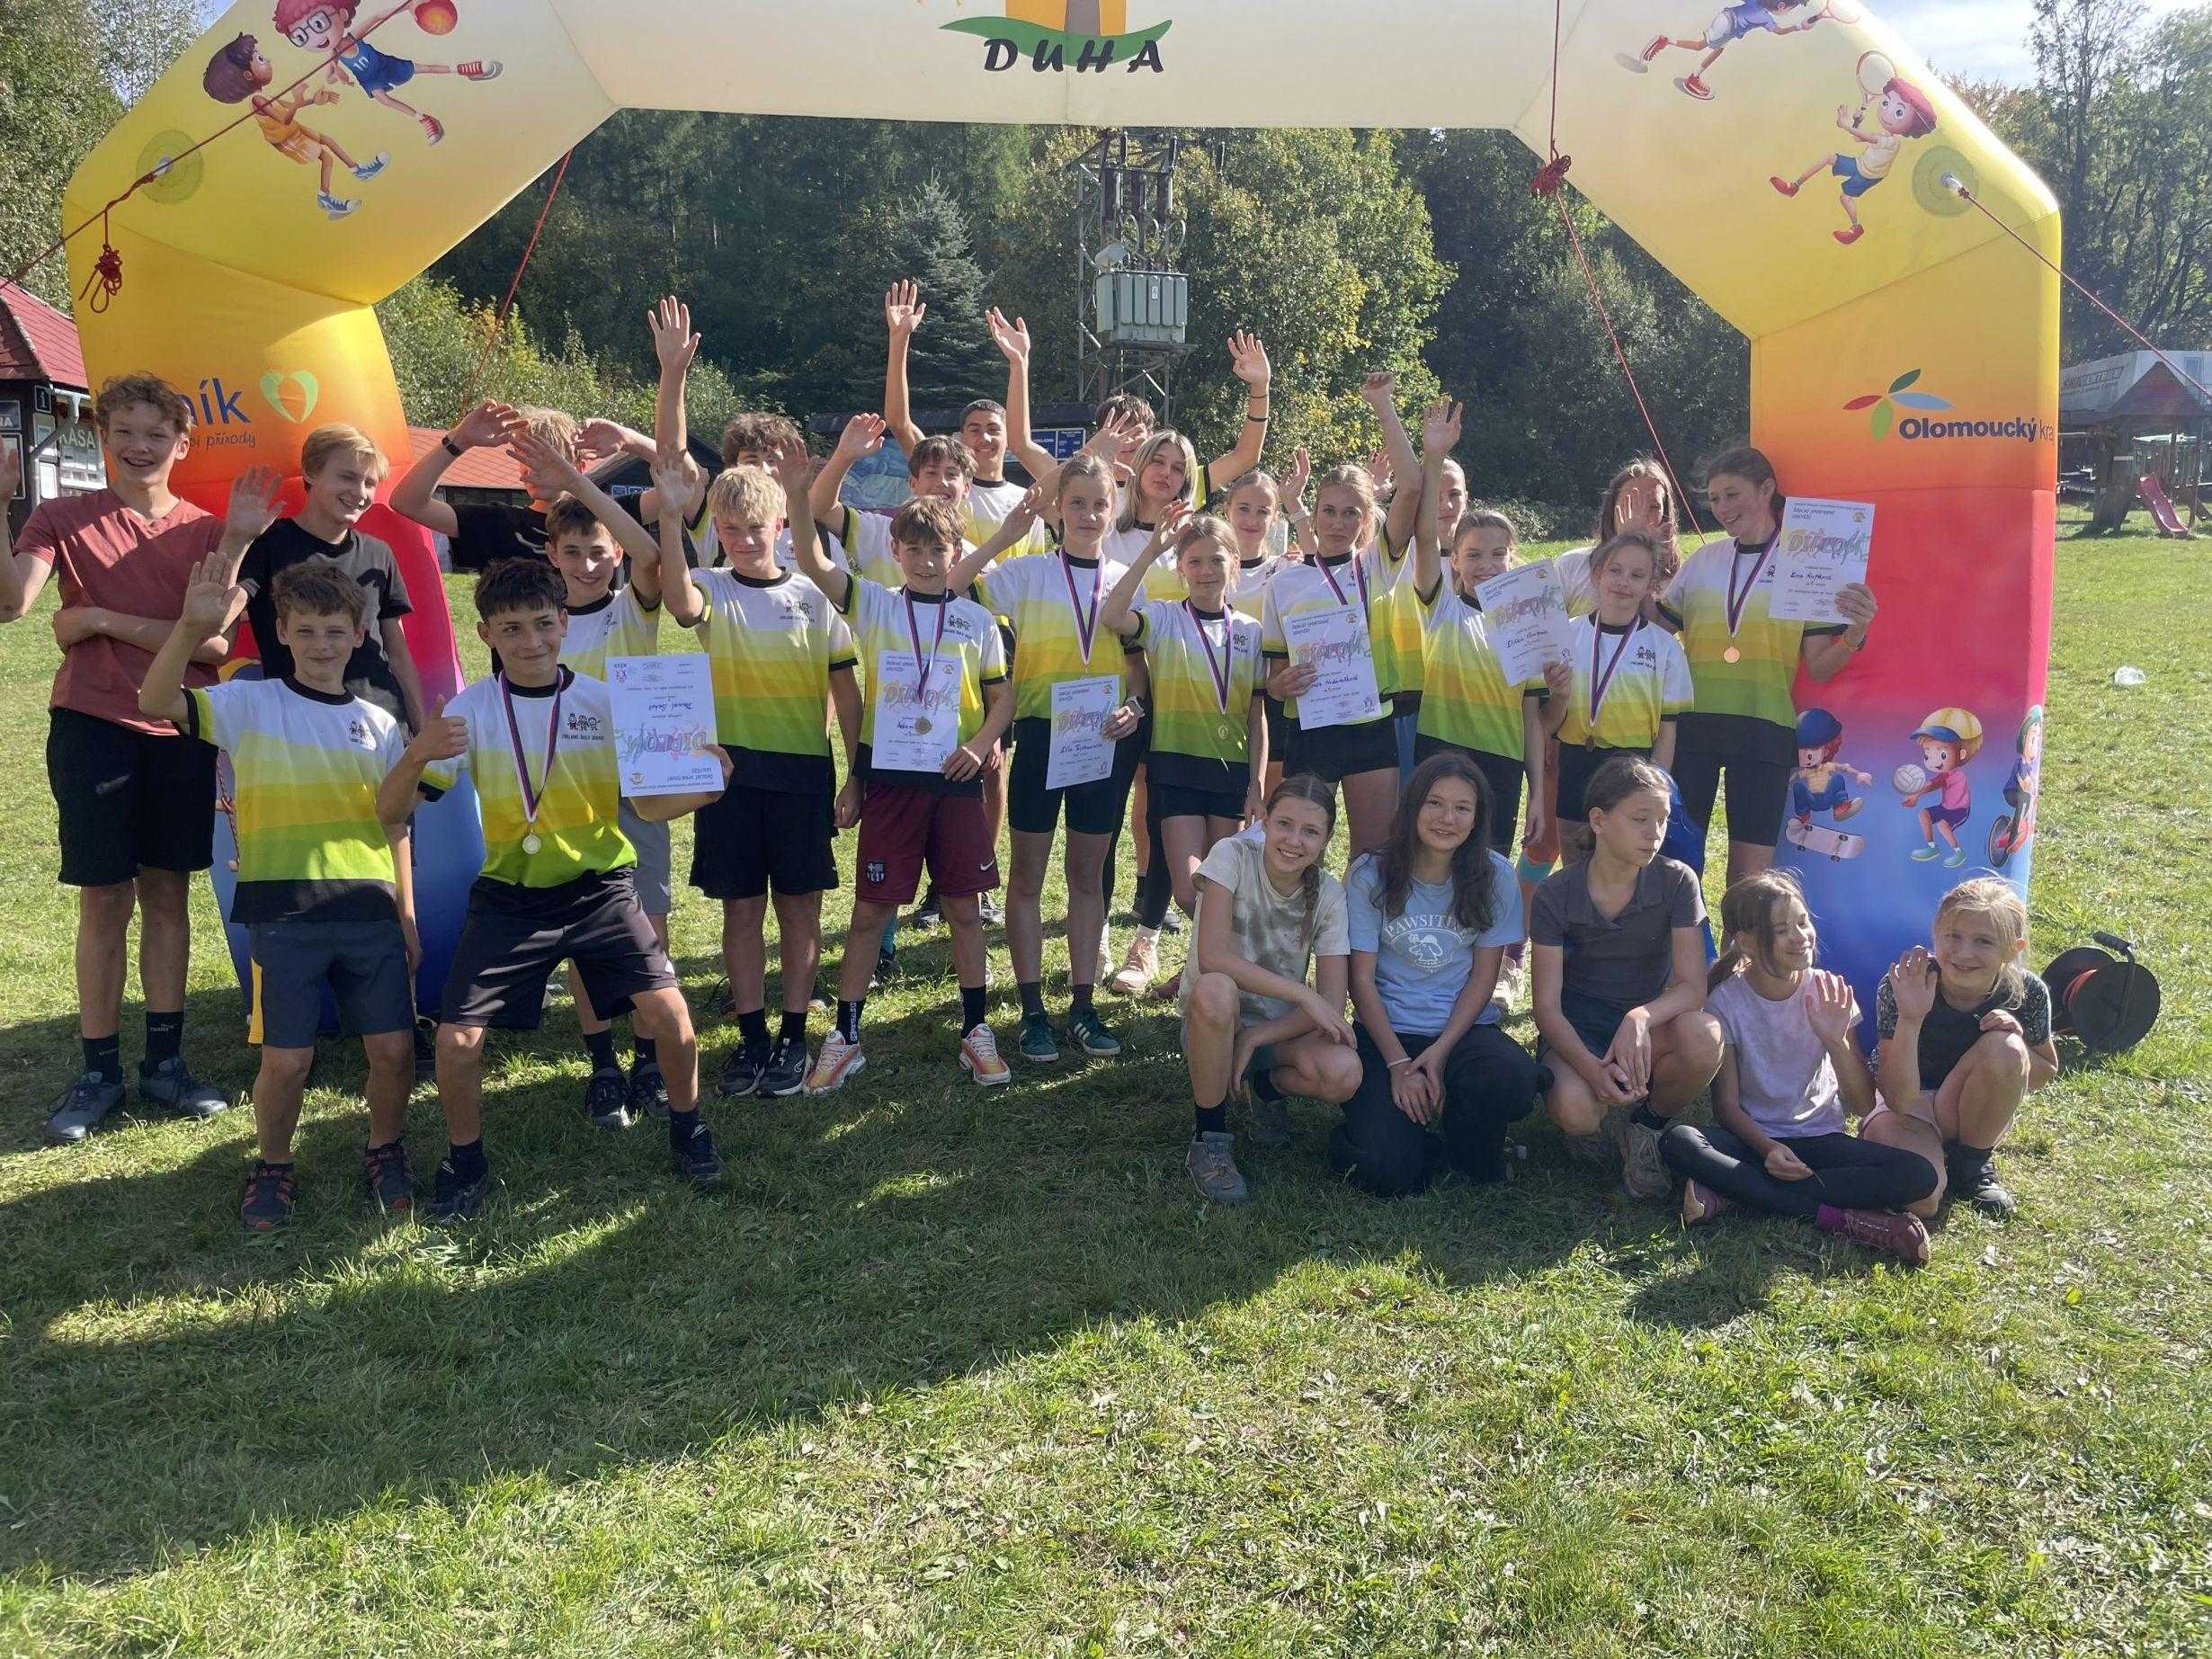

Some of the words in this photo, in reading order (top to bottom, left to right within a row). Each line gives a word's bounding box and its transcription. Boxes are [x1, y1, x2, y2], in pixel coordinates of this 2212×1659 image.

[352, 56, 370, 72] 10
[984, 39, 1164, 74] DUHA
[207, 431, 256, 450] přírody
[1898, 417, 2037, 443] Olomoucký
[885, 683, 953, 710] DIPOM
